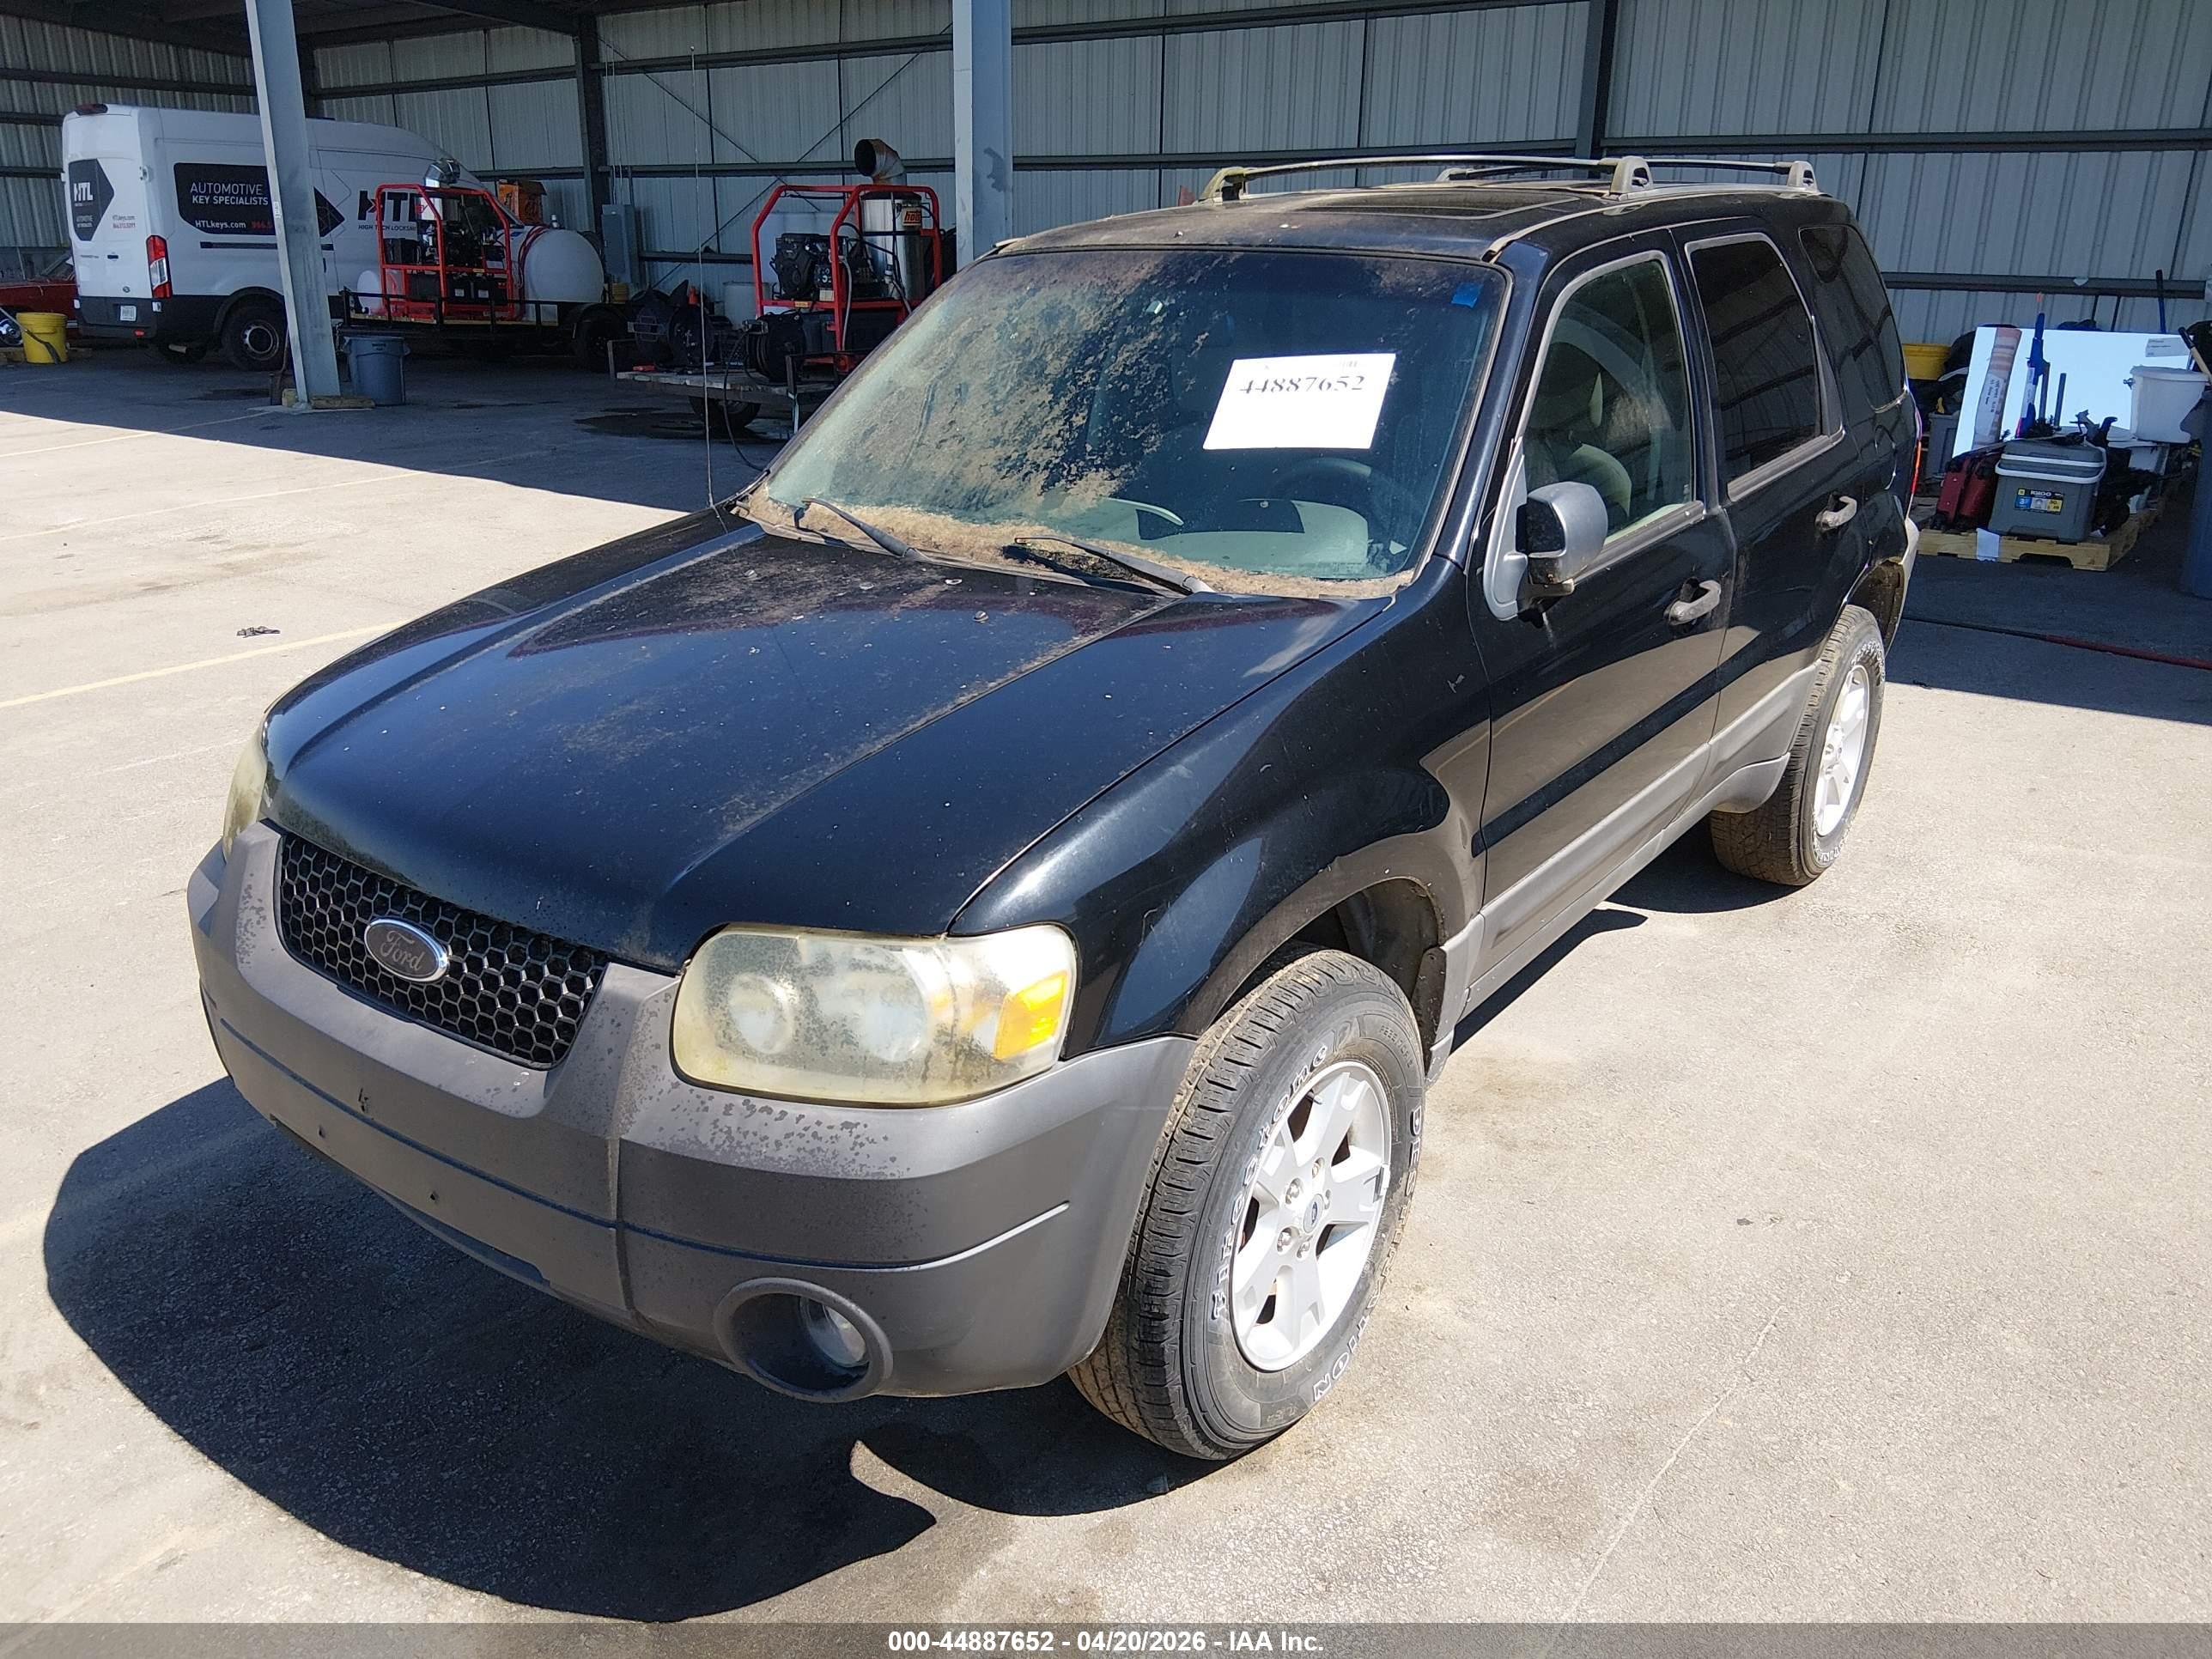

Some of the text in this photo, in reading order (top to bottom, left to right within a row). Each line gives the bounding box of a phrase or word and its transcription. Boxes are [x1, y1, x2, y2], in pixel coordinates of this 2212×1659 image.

[74, 182, 93, 202] HTL
[191, 182, 264, 195] AUTOMOTIVE
[192, 195, 269, 205] KEY SPECIALISTS
[195, 220, 246, 229] HTLkeys.com
[1239, 375, 1366, 394] 44887652
[380, 930, 425, 970] Ford
